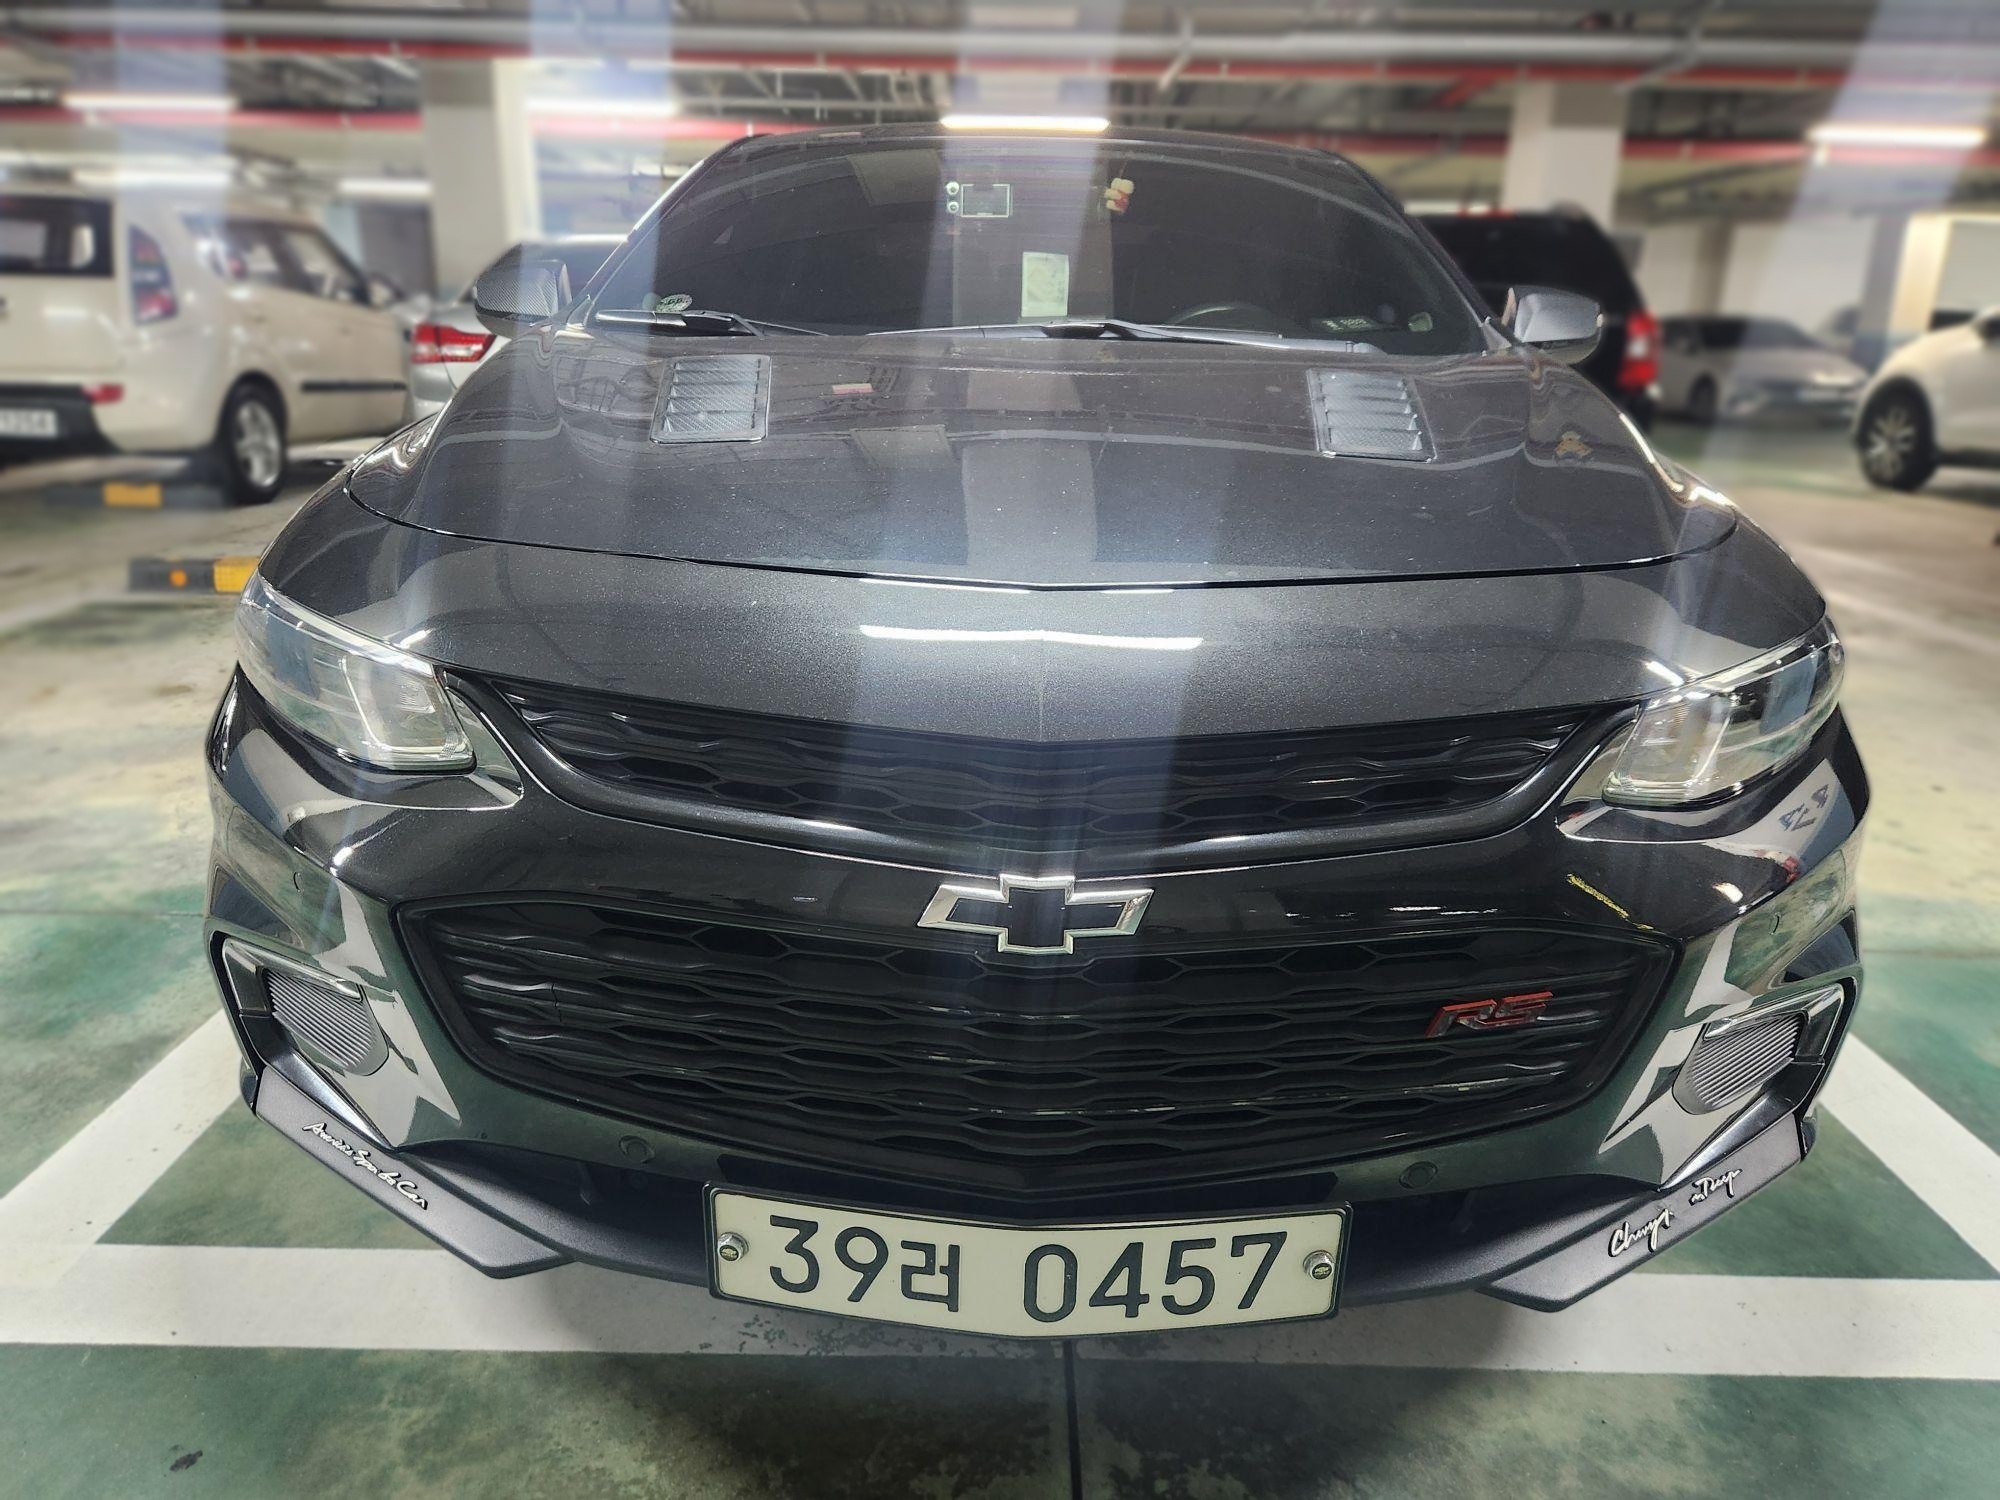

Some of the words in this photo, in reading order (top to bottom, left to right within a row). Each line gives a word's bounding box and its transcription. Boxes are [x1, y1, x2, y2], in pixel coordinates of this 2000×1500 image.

[1424, 991, 1553, 1038] RS
[768, 1214, 960, 1313] 39러
[1023, 1230, 1289, 1323] 0457
